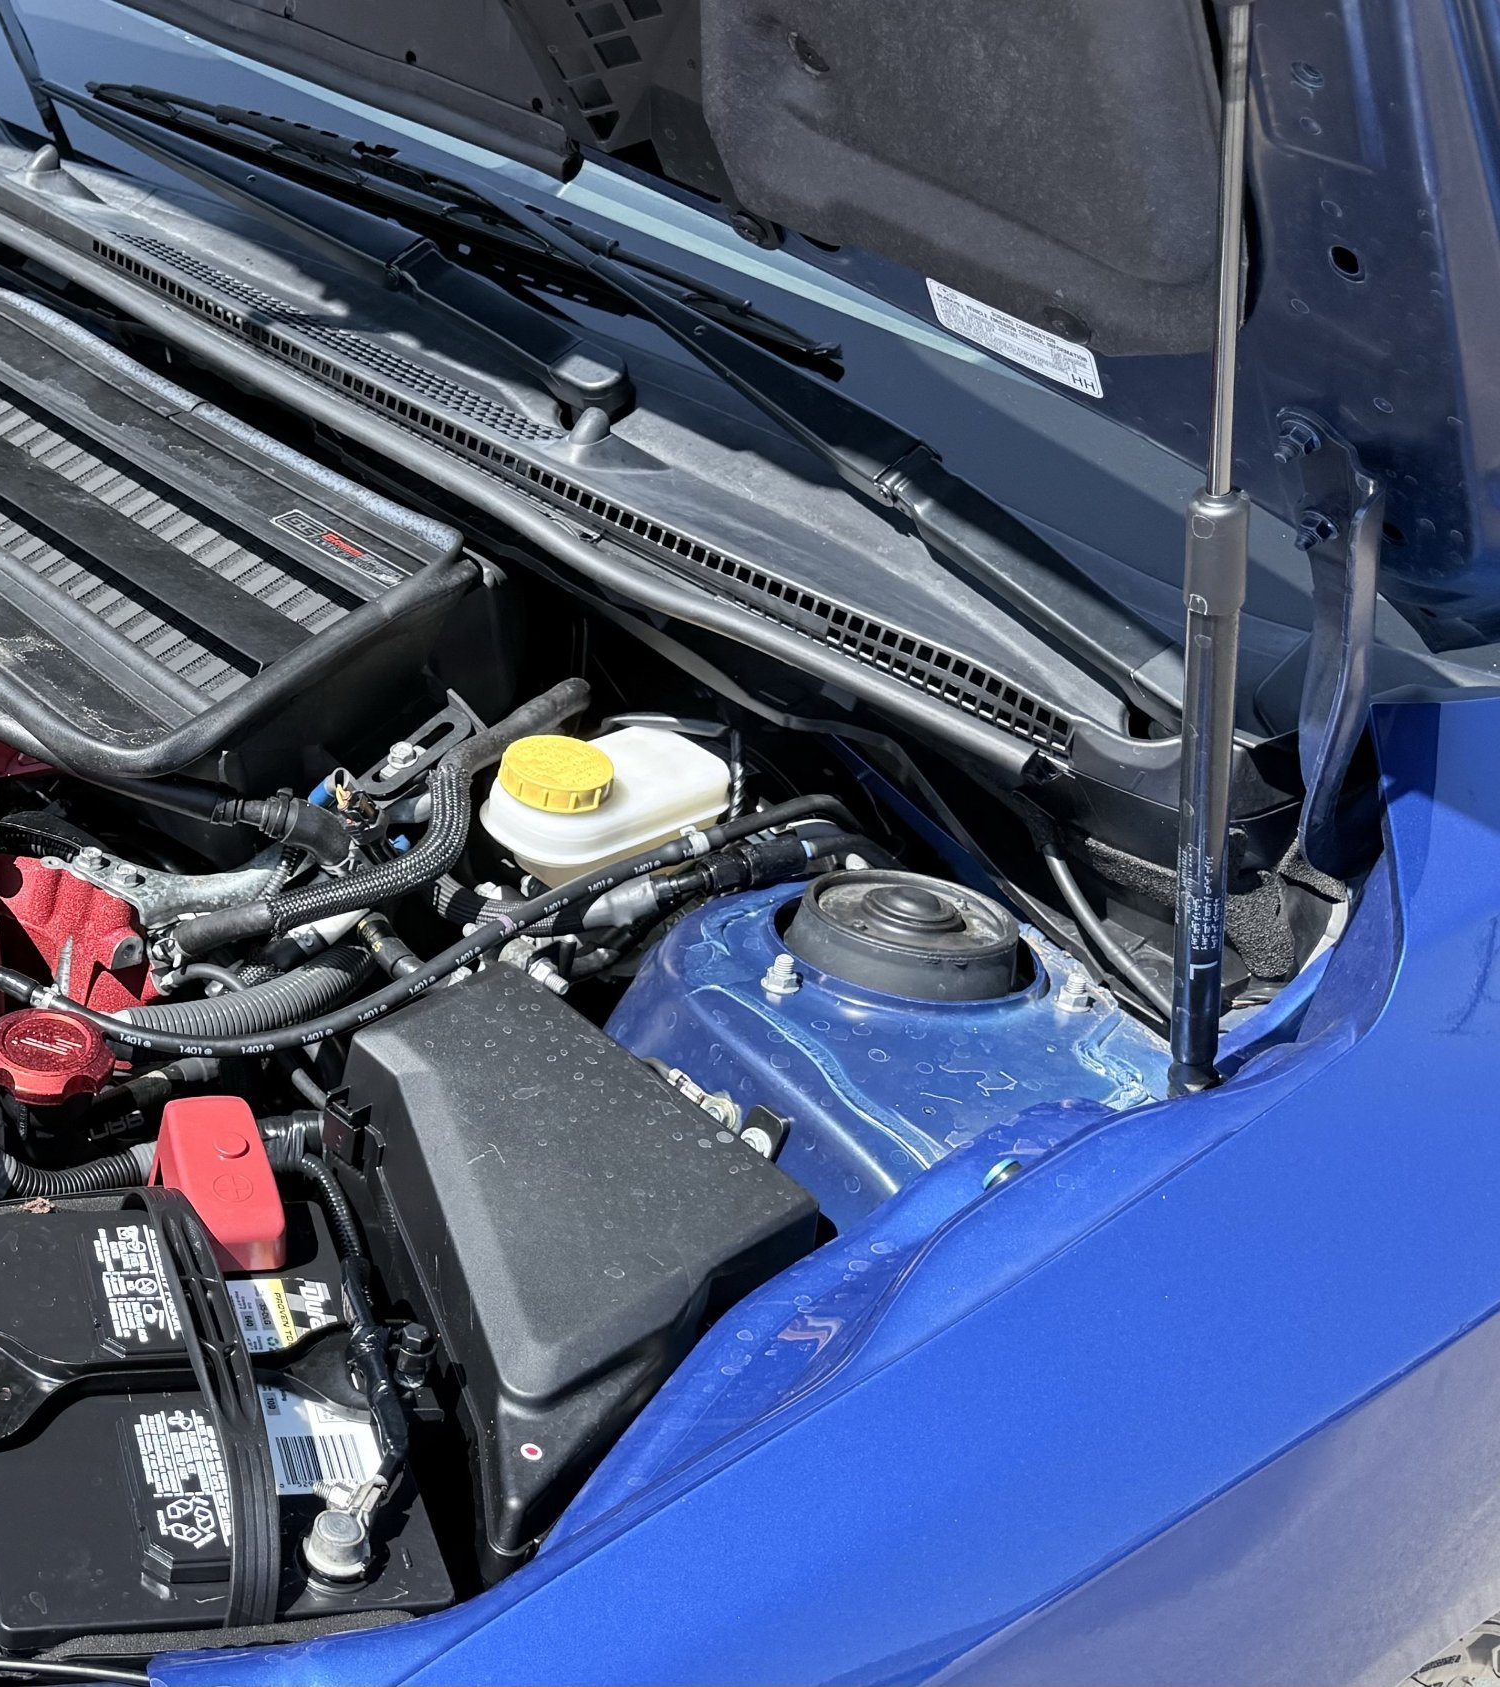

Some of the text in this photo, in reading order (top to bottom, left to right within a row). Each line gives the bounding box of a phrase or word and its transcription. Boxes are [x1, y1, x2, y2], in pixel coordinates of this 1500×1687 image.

[990, 317, 1016, 332] EMISSION
[1018, 330, 1045, 345] CONTROL
[1047, 343, 1088, 362] INFORMATION
[1016, 323, 1056, 344] CORPORATION
[1071, 374, 1096, 392] HH
[120, 1033, 142, 1046] 1401
[179, 1045, 202, 1055] 1401
[240, 1044, 264, 1055] 1401
[301, 1032, 323, 1044] 1401
[358, 1008, 378, 1022] 1401
[408, 979, 427, 995] 1401
[455, 950, 473, 966] 1401
[633, 861, 653, 875] 1401
[244, 1315, 254, 1327] 640
[274, 1292, 290, 1328] PROVEN
